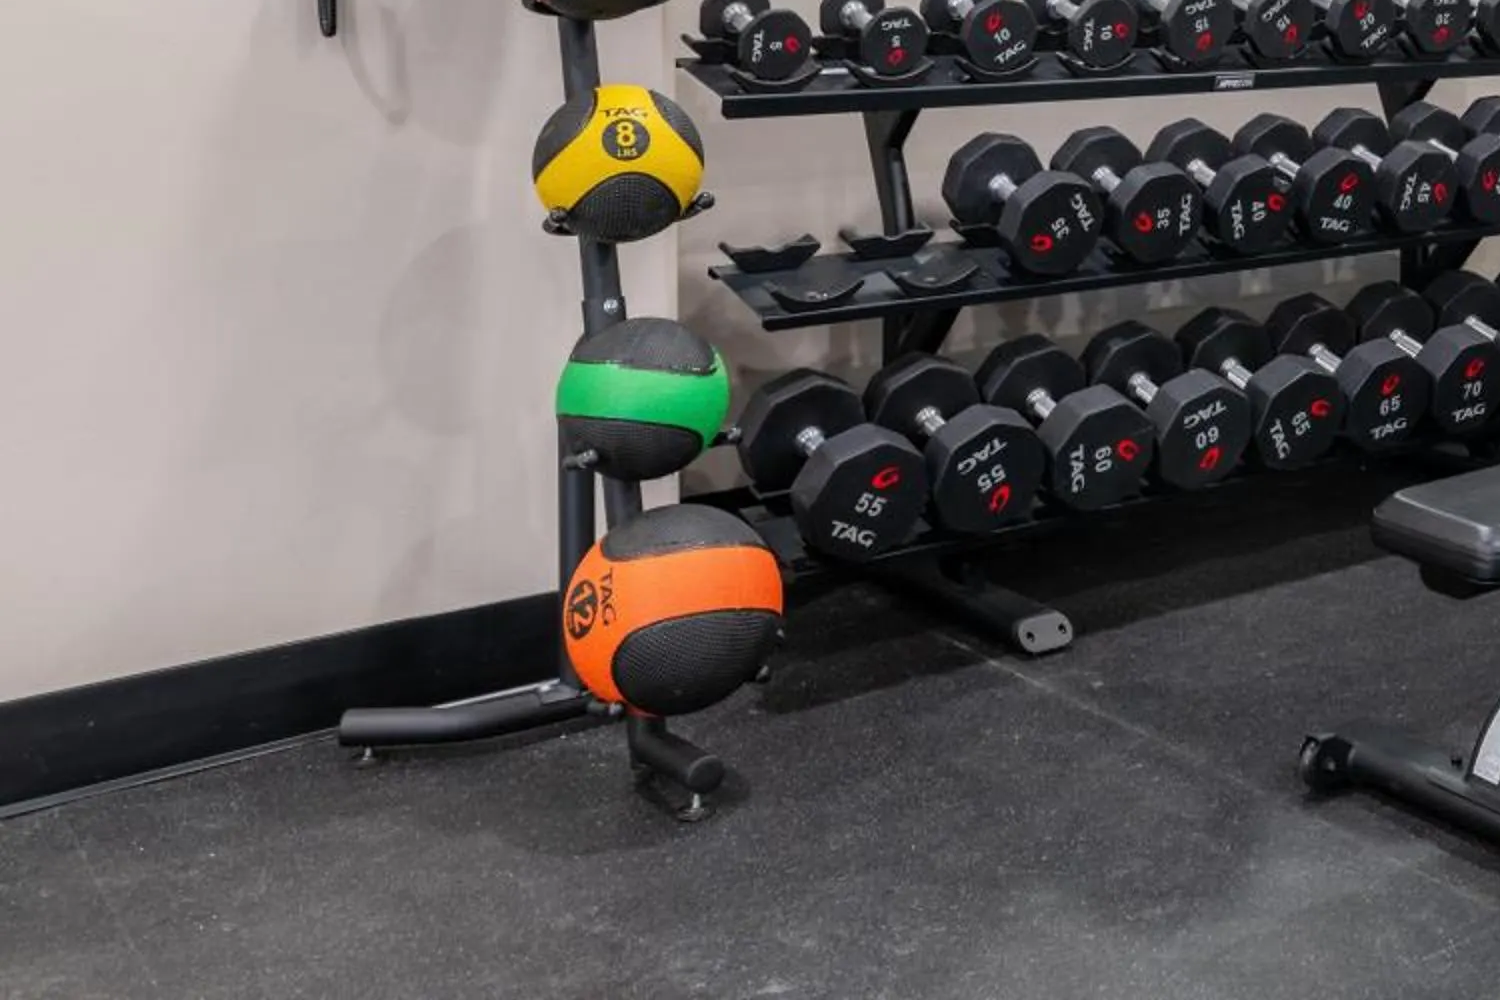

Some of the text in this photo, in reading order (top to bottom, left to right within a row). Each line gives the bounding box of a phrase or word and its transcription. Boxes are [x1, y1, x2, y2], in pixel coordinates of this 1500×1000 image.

[993, 28, 1011, 44] 10
[1083, 18, 1094, 51] TAG
[1101, 25, 1112, 40] 10
[752, 29, 765, 63] TAG
[994, 40, 1027, 64] TAG
[599, 107, 649, 117] TAG
[616, 121, 636, 146] 8
[1070, 193, 1095, 231] TAG
[1333, 193, 1353, 210] 40
[1157, 208, 1171, 230] 35
[1178, 193, 1193, 236] TAG
[1320, 217, 1350, 232] TAG
[1051, 217, 1070, 239] 35
[1463, 381, 1482, 400] 70
[1183, 400, 1227, 429] TAG
[1380, 394, 1401, 416] 65
[1451, 402, 1486, 423] TAG
[1292, 411, 1311, 436] 65
[1369, 417, 1407, 440] TAG
[1195, 426, 1219, 449] 60
[1270, 419, 1291, 459] TAG
[957, 437, 1008, 475] TAG
[1095, 445, 1112, 473] 60
[977, 464, 1006, 494] 55
[1070, 444, 1085, 494] TAG
[854, 492, 887, 517] 55
[831, 520, 877, 548] TAG
[573, 583, 593, 632] 12
[600, 567, 616, 626] TAG
